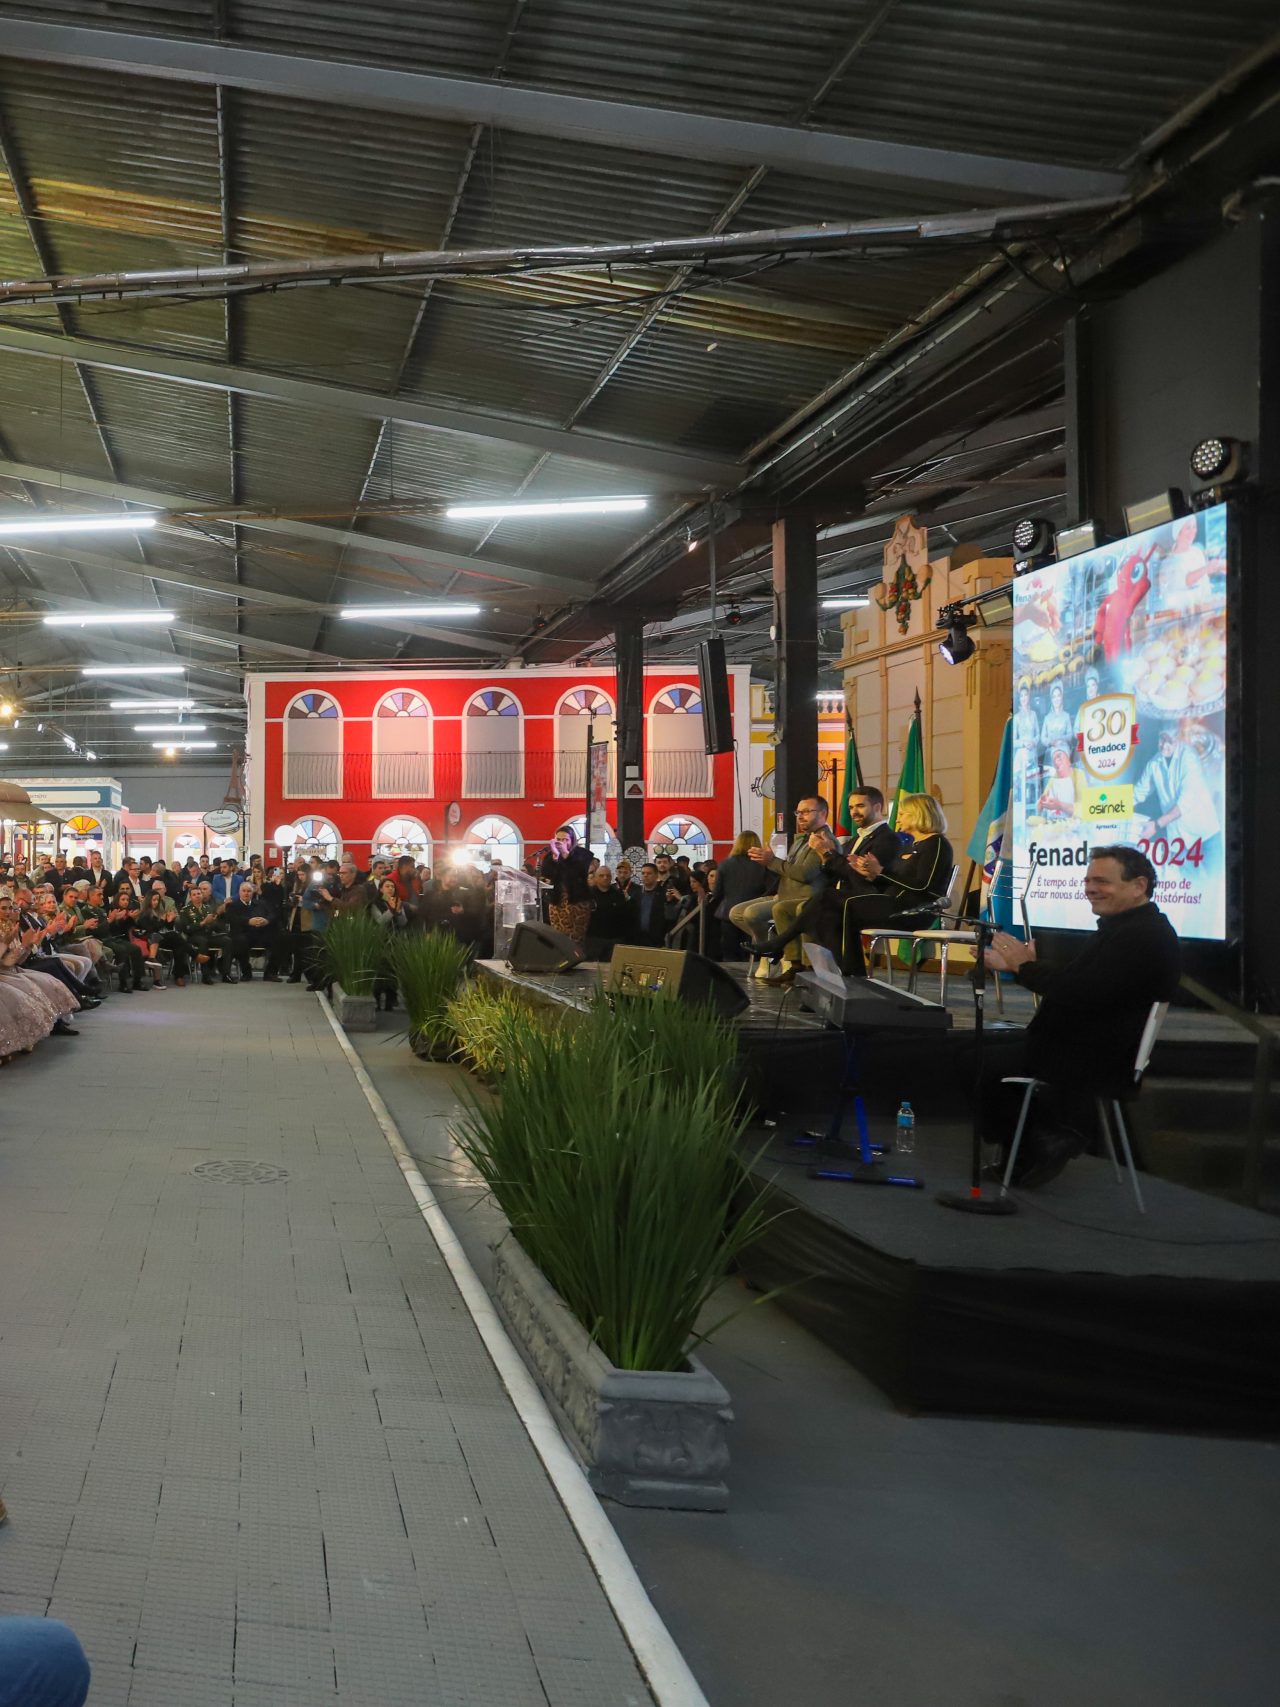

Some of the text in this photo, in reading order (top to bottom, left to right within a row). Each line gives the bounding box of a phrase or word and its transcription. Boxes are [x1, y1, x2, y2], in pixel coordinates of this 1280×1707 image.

[1088, 742, 1127, 755] fenadoce
[1097, 758, 1116, 769] 2024
[1088, 800, 1126, 815] osirnet
[1028, 837, 1205, 868] fenad 2024
[1043, 878, 1067, 889] tempo
[1068, 877, 1078, 887] de
[1155, 881, 1177, 892] mpo
[1178, 878, 1192, 890] de
[1030, 889, 1048, 899] criar
[1050, 891, 1073, 900] novas
[1153, 892, 1202, 905] histórias!
